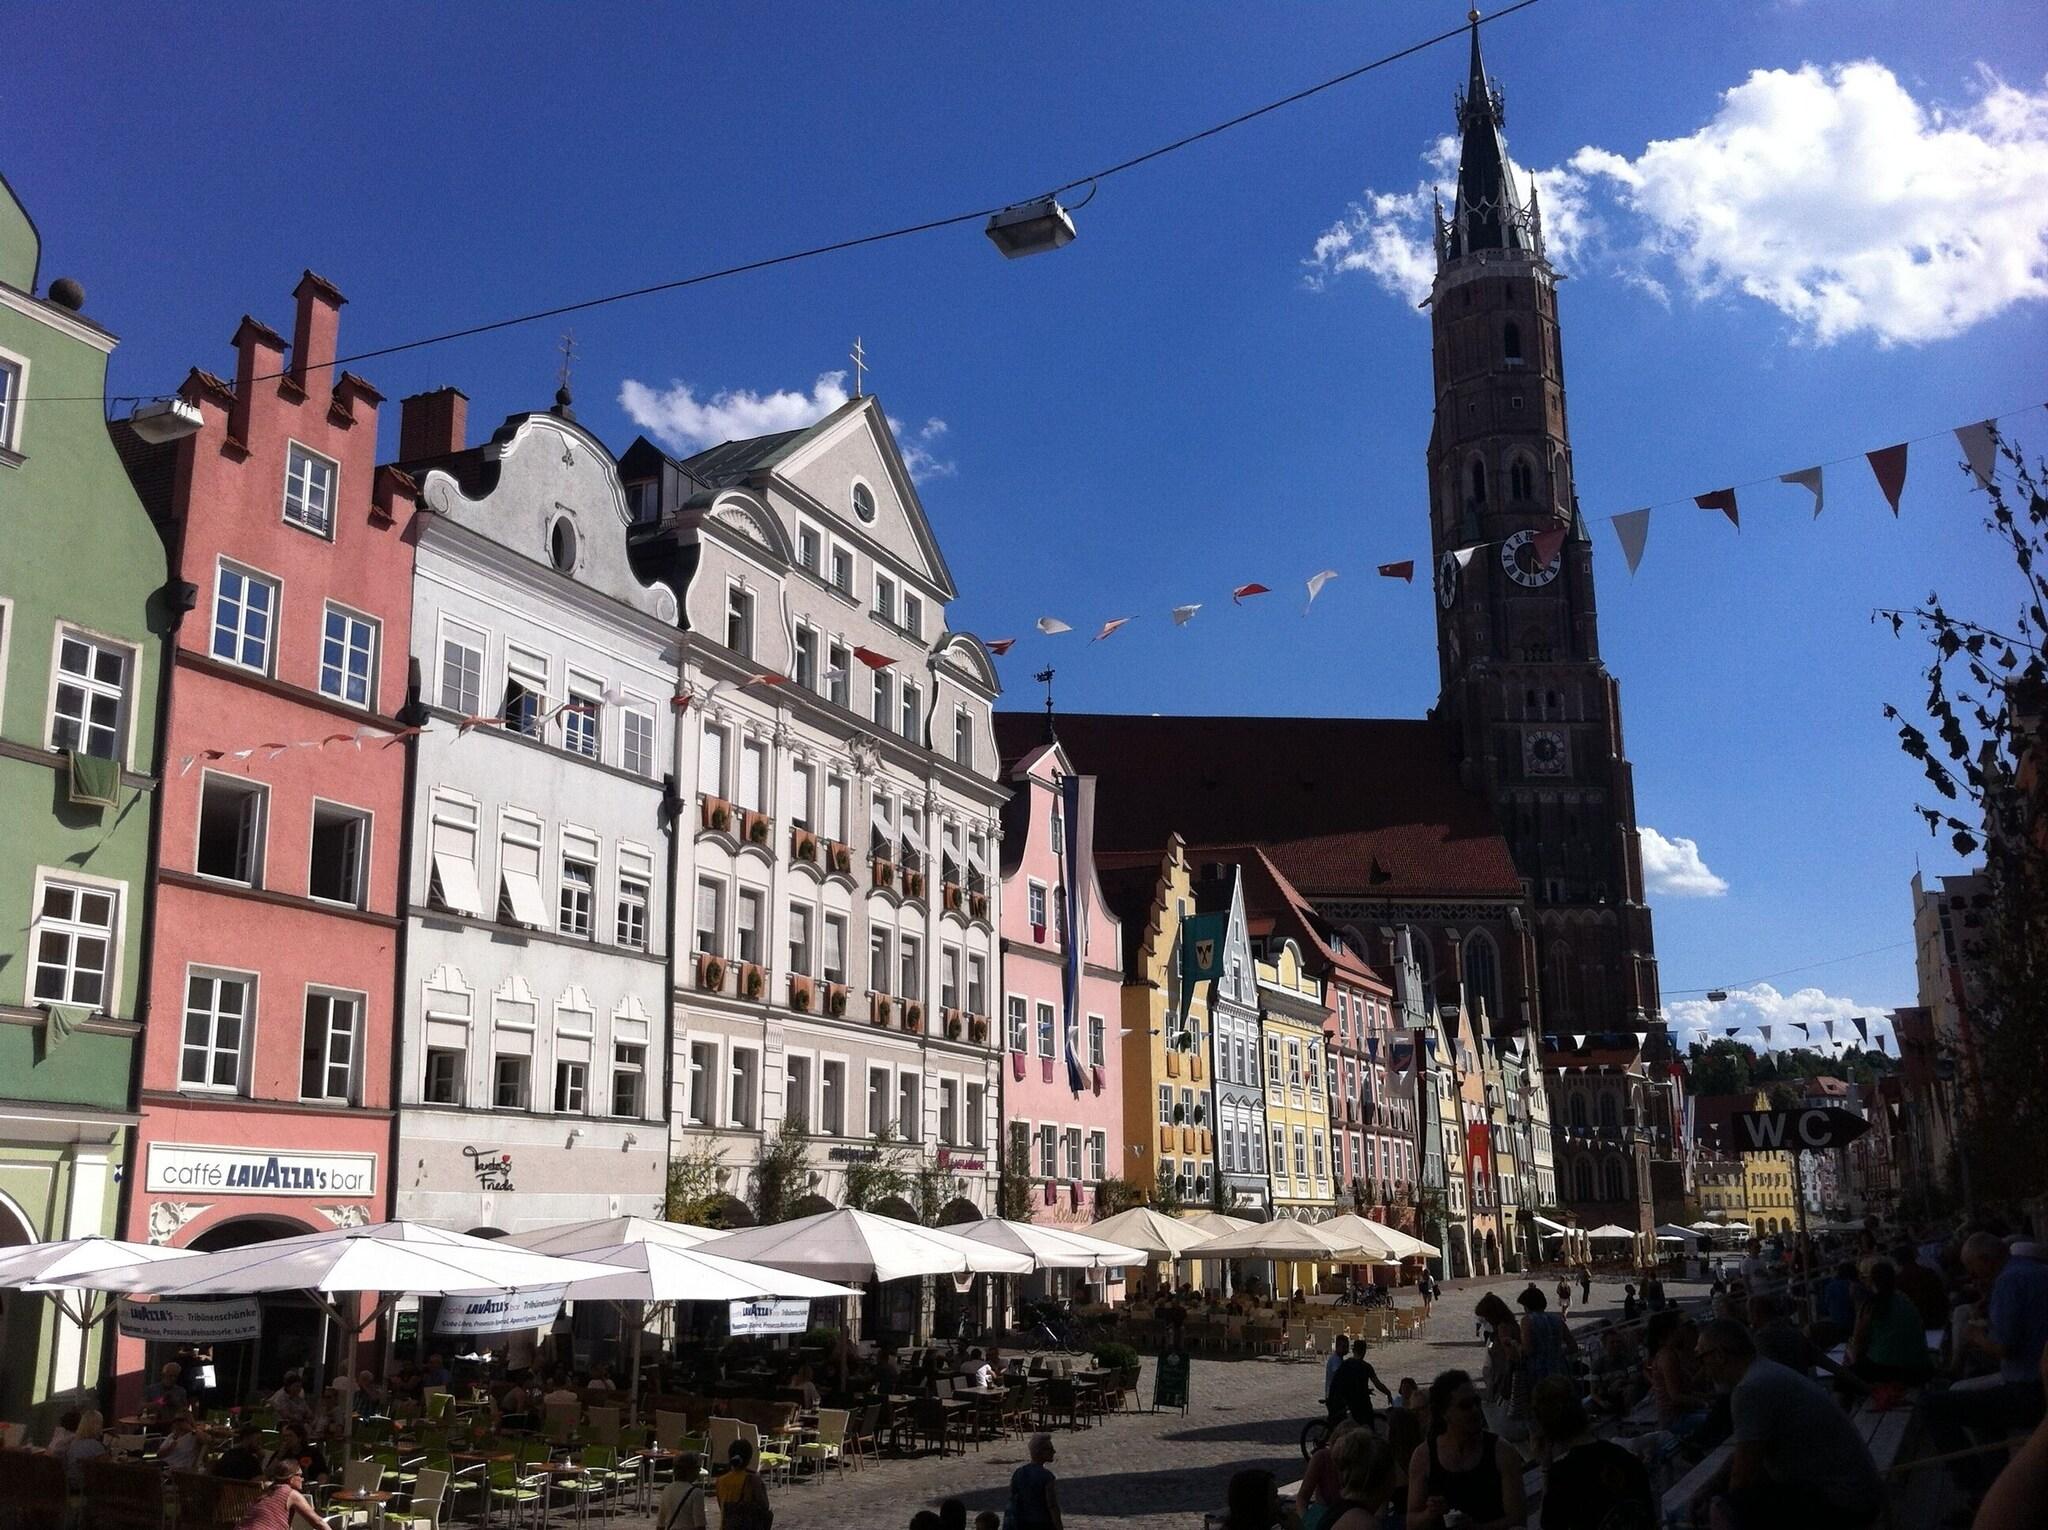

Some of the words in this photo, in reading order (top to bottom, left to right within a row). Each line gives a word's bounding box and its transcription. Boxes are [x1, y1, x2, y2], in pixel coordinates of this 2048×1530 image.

[1743, 1109, 1833, 1147] WC
[163, 1162, 222, 1187] caffé
[225, 1157, 327, 1189] LAVAZZA's
[331, 1168, 364, 1190] bar
